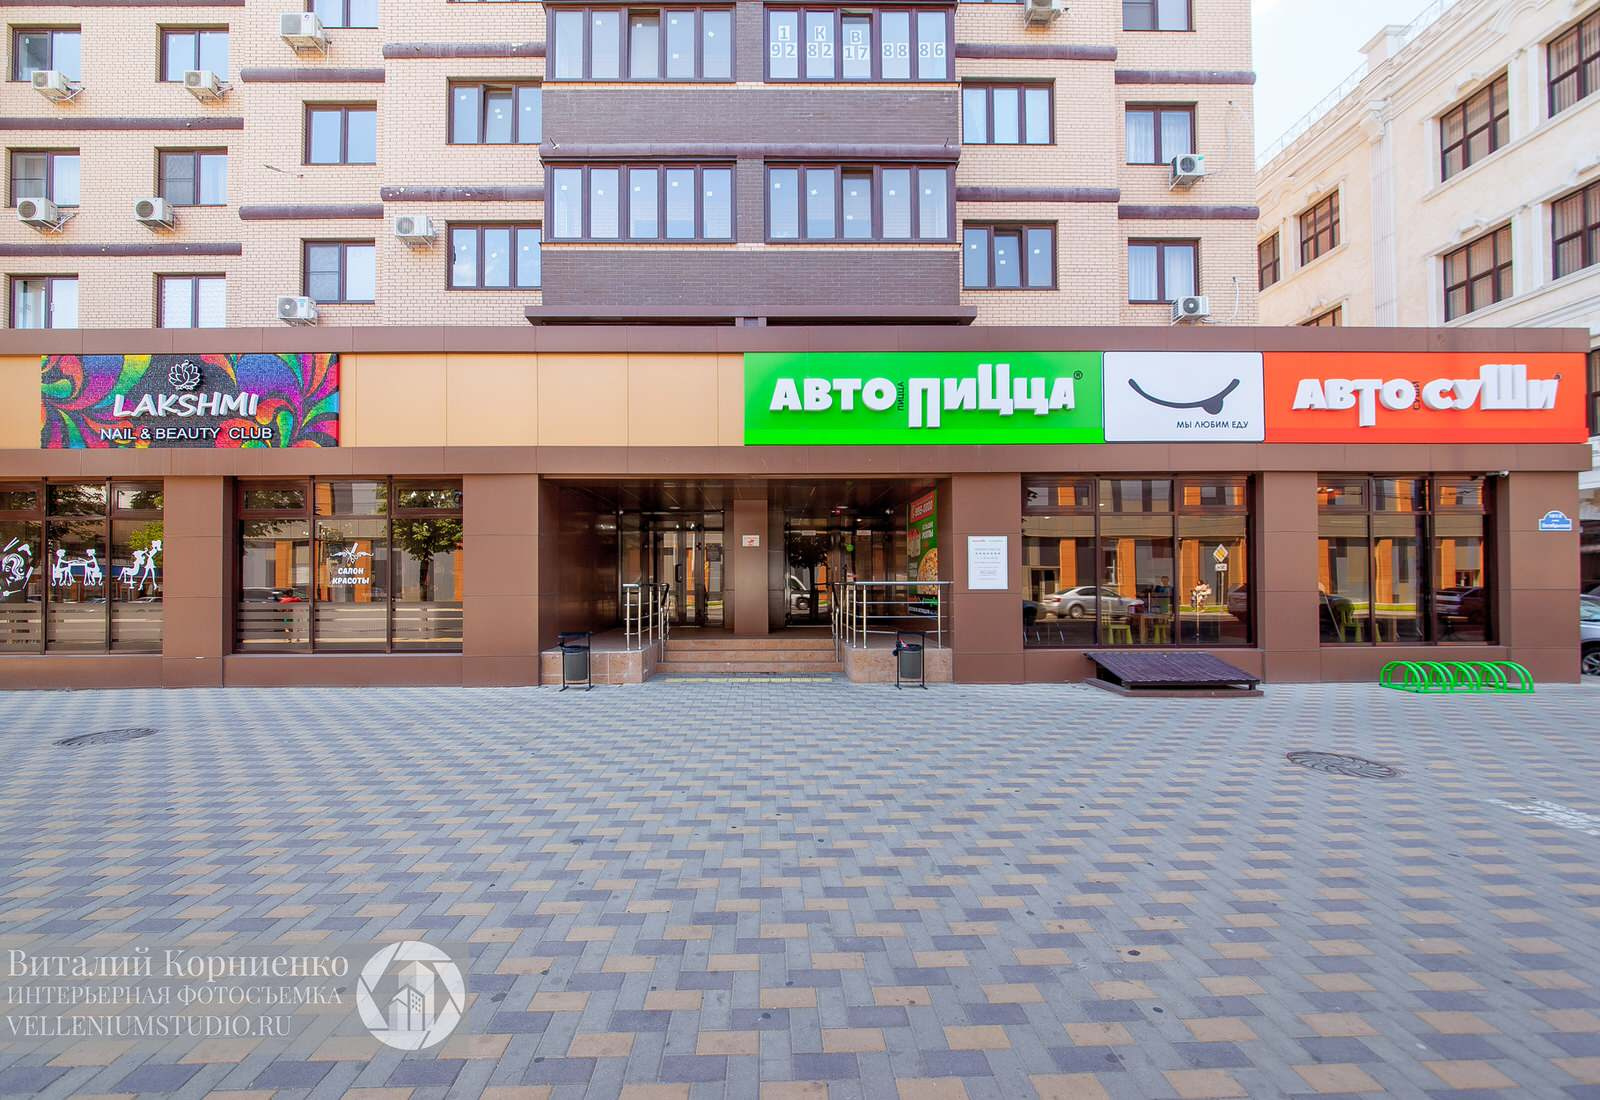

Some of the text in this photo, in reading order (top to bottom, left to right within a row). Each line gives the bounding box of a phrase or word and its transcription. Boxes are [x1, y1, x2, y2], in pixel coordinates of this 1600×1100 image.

[113, 391, 259, 417] LAKSHMI
[1232, 421, 1248, 429] ЕДУ
[100, 427, 272, 440] NAIL & BEAUTY CLUB
[337, 567, 364, 575] САЛОН
[332, 577, 370, 585] КРАСОТЫ
